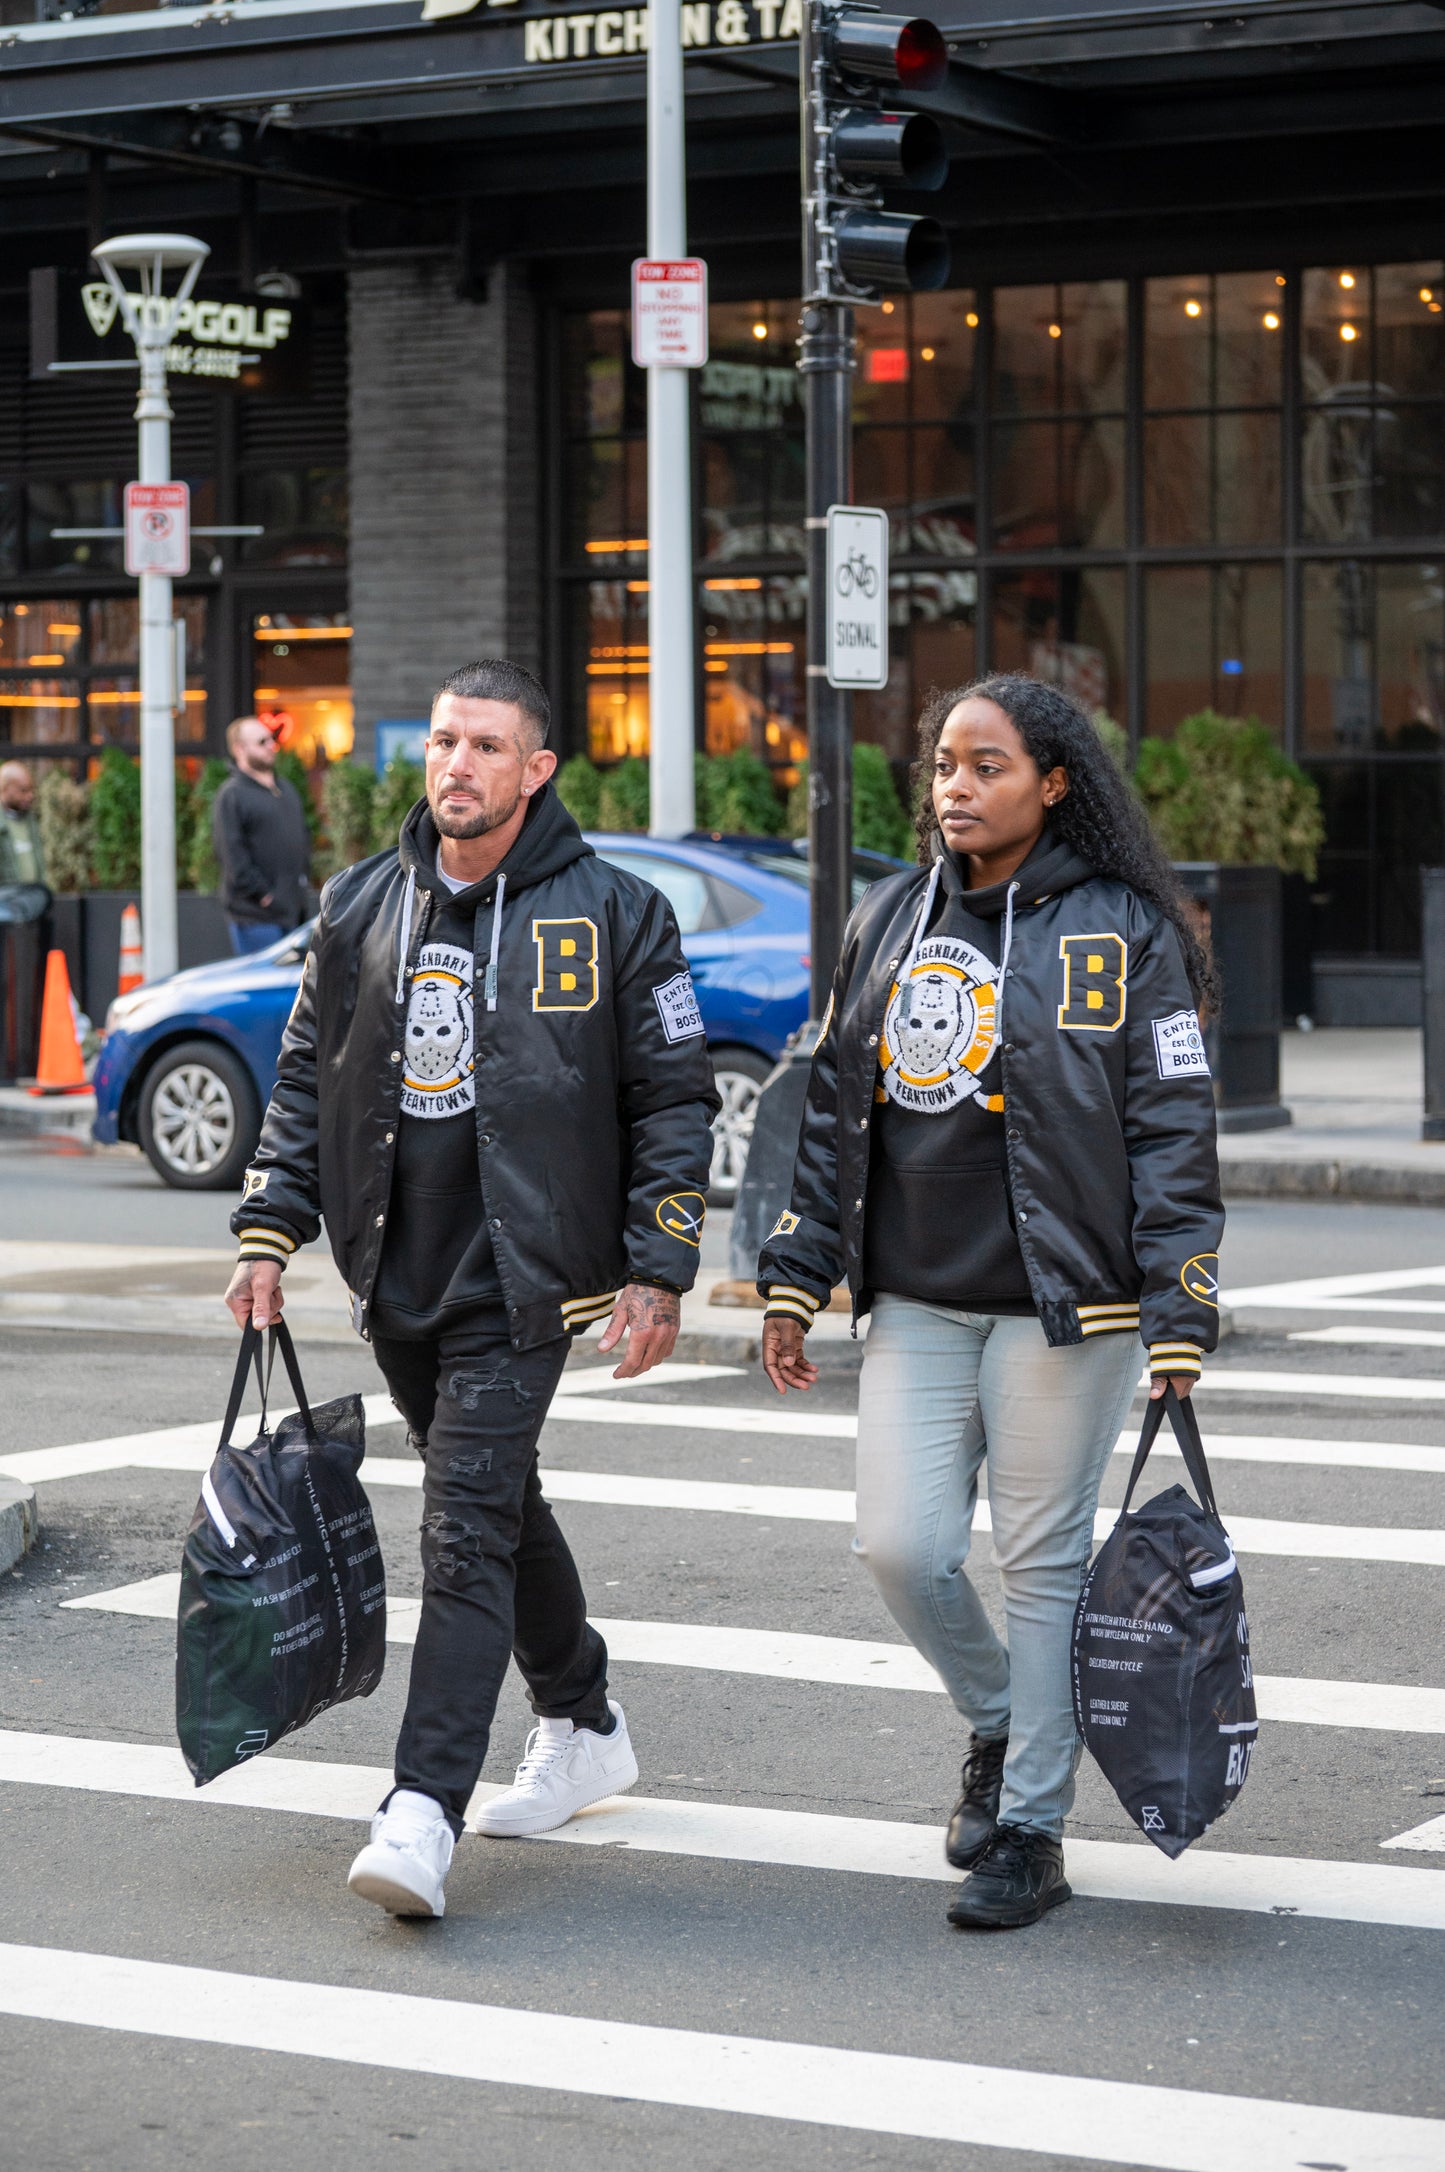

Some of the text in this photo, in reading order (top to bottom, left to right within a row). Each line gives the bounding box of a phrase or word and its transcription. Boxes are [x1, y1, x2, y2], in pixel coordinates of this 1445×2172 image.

[524, 4, 710, 62] KITCHN
[715, 2, 750, 45] &
[836, 621, 879, 648] SIGNAL
[532, 917, 599, 1012] B
[914, 944, 978, 967] EGENDARY
[1057, 933, 1127, 1032] B
[675, 1012, 703, 1029] BOST
[975, 1004, 995, 1048] GUYS
[896, 1080, 957, 1106] BEANTOWN
[252, 1592, 279, 1608] WASH
[273, 1631, 286, 1642] DO
[1143, 1620, 1173, 1634] HAND
[1130, 1632, 1152, 1644] ONLY
[1119, 1661, 1144, 1673] CYCLE
[1110, 1701, 1129, 1712] SUEDE
